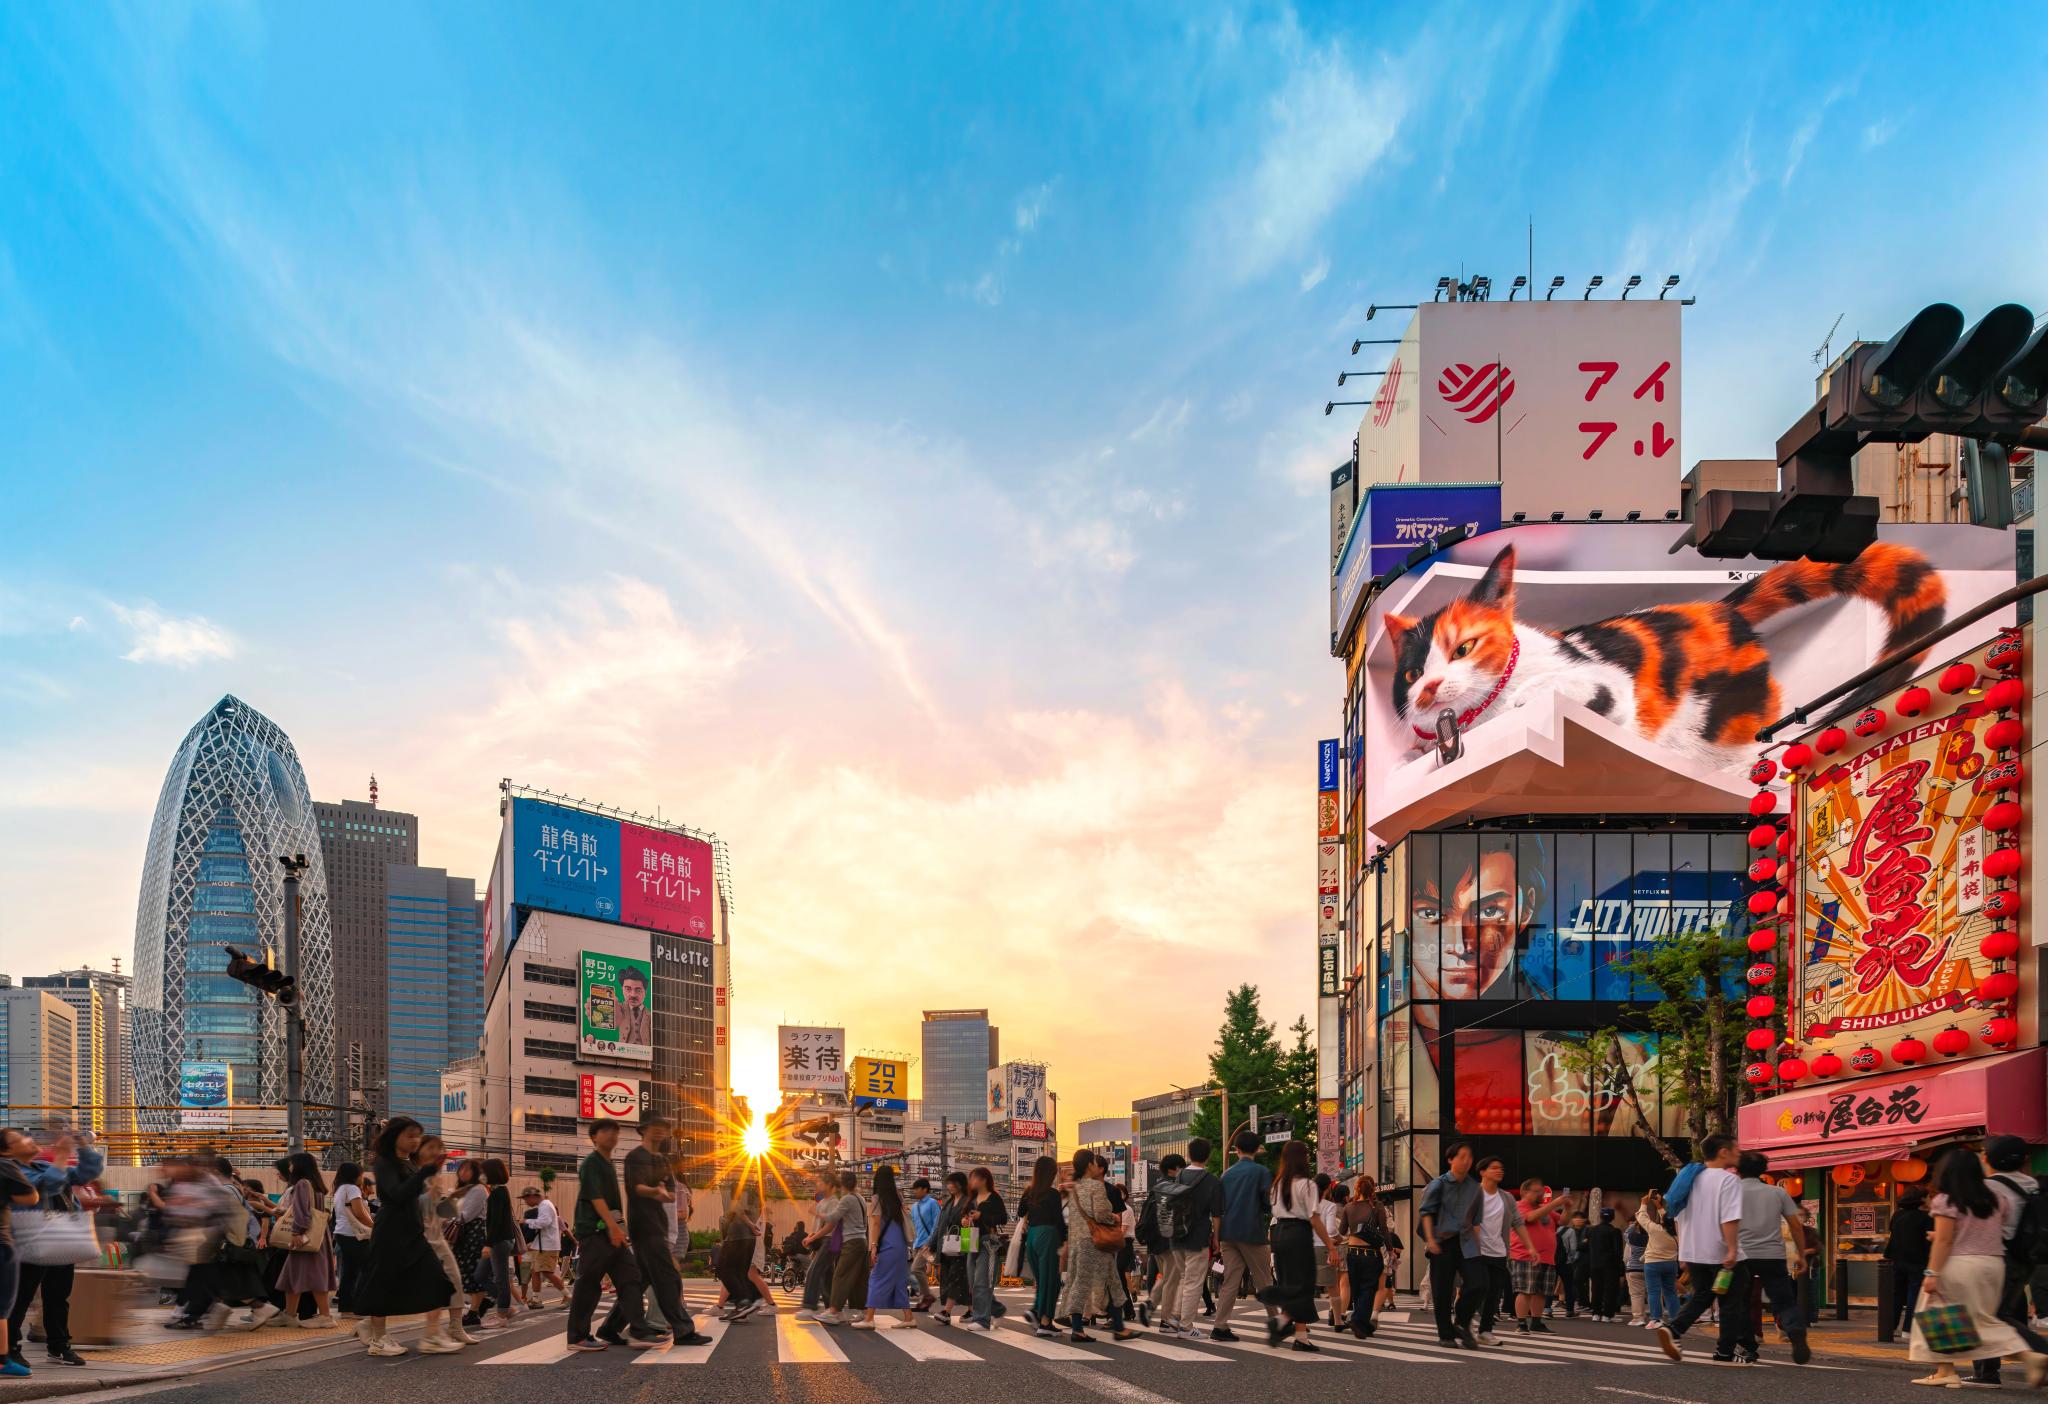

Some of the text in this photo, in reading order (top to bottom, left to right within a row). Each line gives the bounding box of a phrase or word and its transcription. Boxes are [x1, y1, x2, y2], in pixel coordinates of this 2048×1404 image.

[1578, 361, 1671, 402] アイ
[1578, 422, 1675, 460] フル
[1844, 719, 1949, 771] YATAIEN
[541, 824, 597, 857] 龍角散
[533, 849, 608, 883] ダイレクト
[643, 847, 691, 879] 龍角散
[1840, 759, 1953, 994] 屋台苑
[635, 870, 701, 902] ダイレクト
[1572, 899, 1632, 935] CITY
[585, 958, 615, 972] 野口の
[586, 969, 616, 981] サプリ
[1322, 949, 1335, 994] 宝石広場
[1840, 998, 1947, 1030] SHINJUKU
[791, 1032, 833, 1042] ラクマチ
[784, 1045, 841, 1071] 楽待
[868, 1061, 896, 1078] プロ
[868, 1078, 896, 1095] ミス
[1013, 1065, 1046, 1090] カラオケ
[583, 1079, 592, 1114] 回転寿司
[598, 1093, 636, 1103] スシロー
[876, 1098, 889, 1107] 6F
[1016, 1097, 1043, 1121] 鉄人
[1025, 1087, 1033, 1101] の
[1820, 1085, 1930, 1139] 屋台苑
[1149, 1162, 1160, 1170] THE
